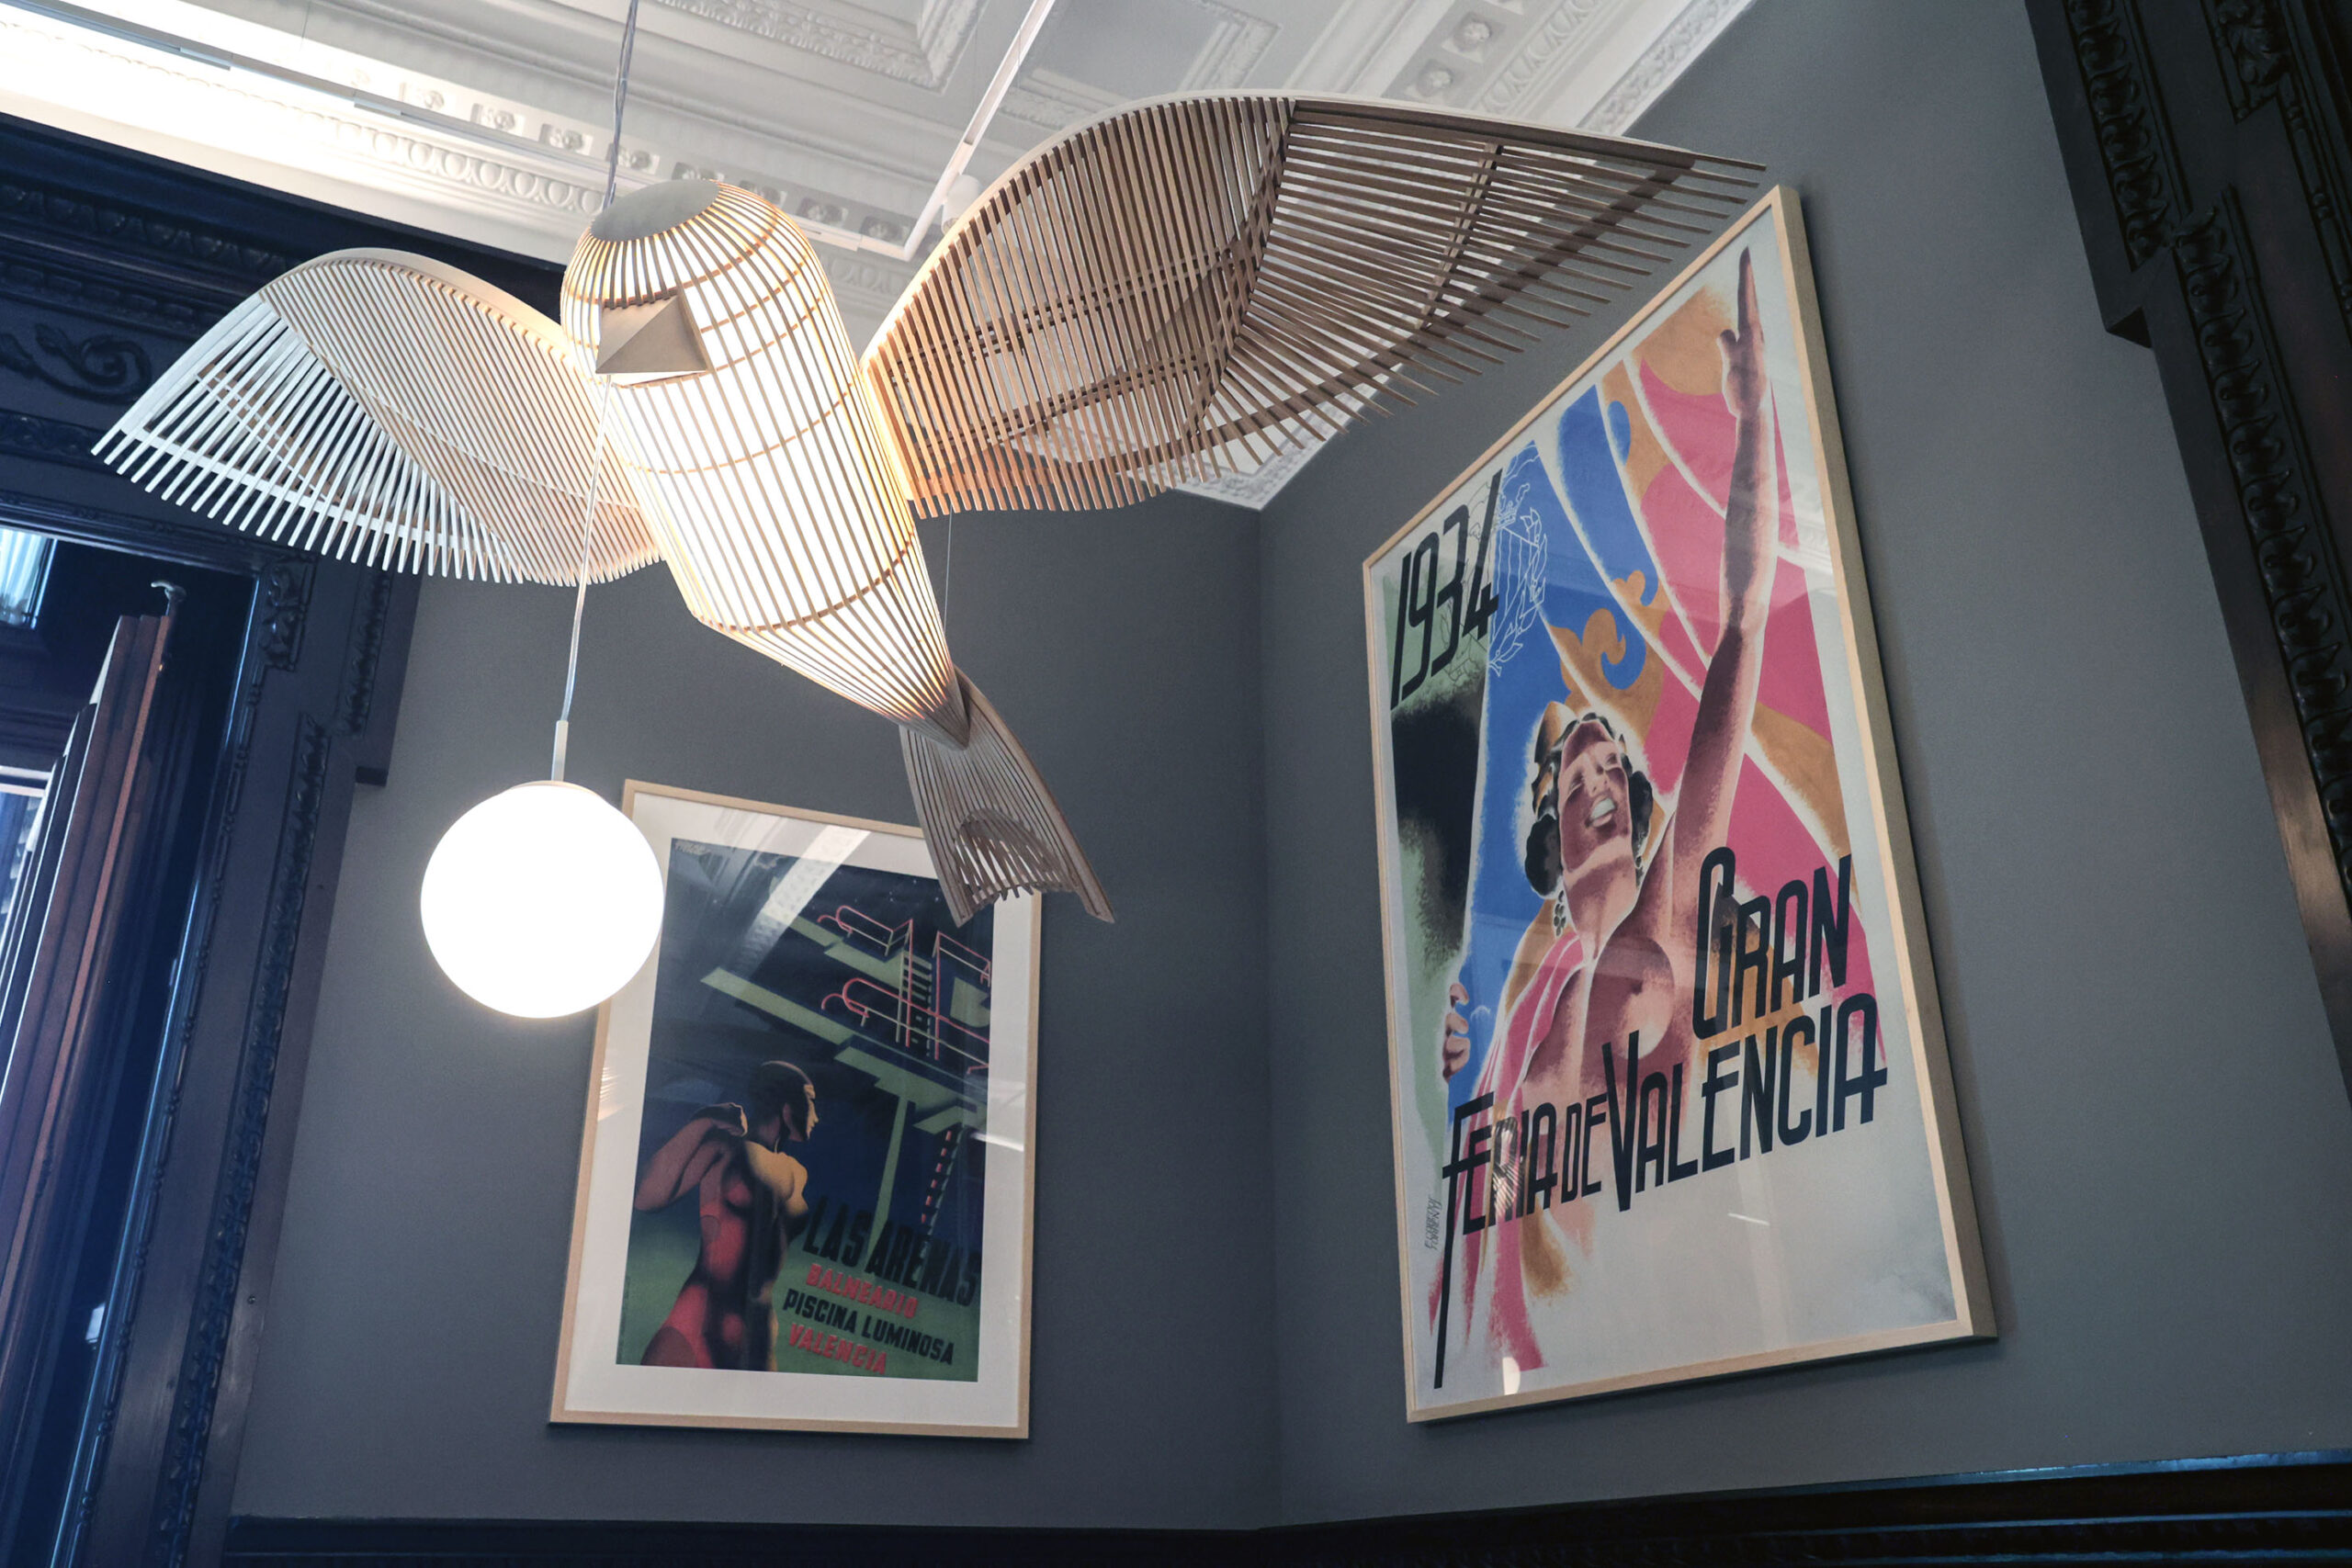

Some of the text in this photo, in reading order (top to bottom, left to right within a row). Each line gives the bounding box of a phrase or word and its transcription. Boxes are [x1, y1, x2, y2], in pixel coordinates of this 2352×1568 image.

[1390, 468, 1503, 711] 1934
[1692, 846, 1851, 1040] GRAN
[1434, 993, 1888, 1389] FERIA DE VALENCIA
[802, 1195, 982, 1307] LAS ARENAS
[806, 1263, 920, 1320] BALNEARIO
[782, 1288, 955, 1366] PISCINA LUMINOSA
[788, 1323, 888, 1375] VALENCIA
